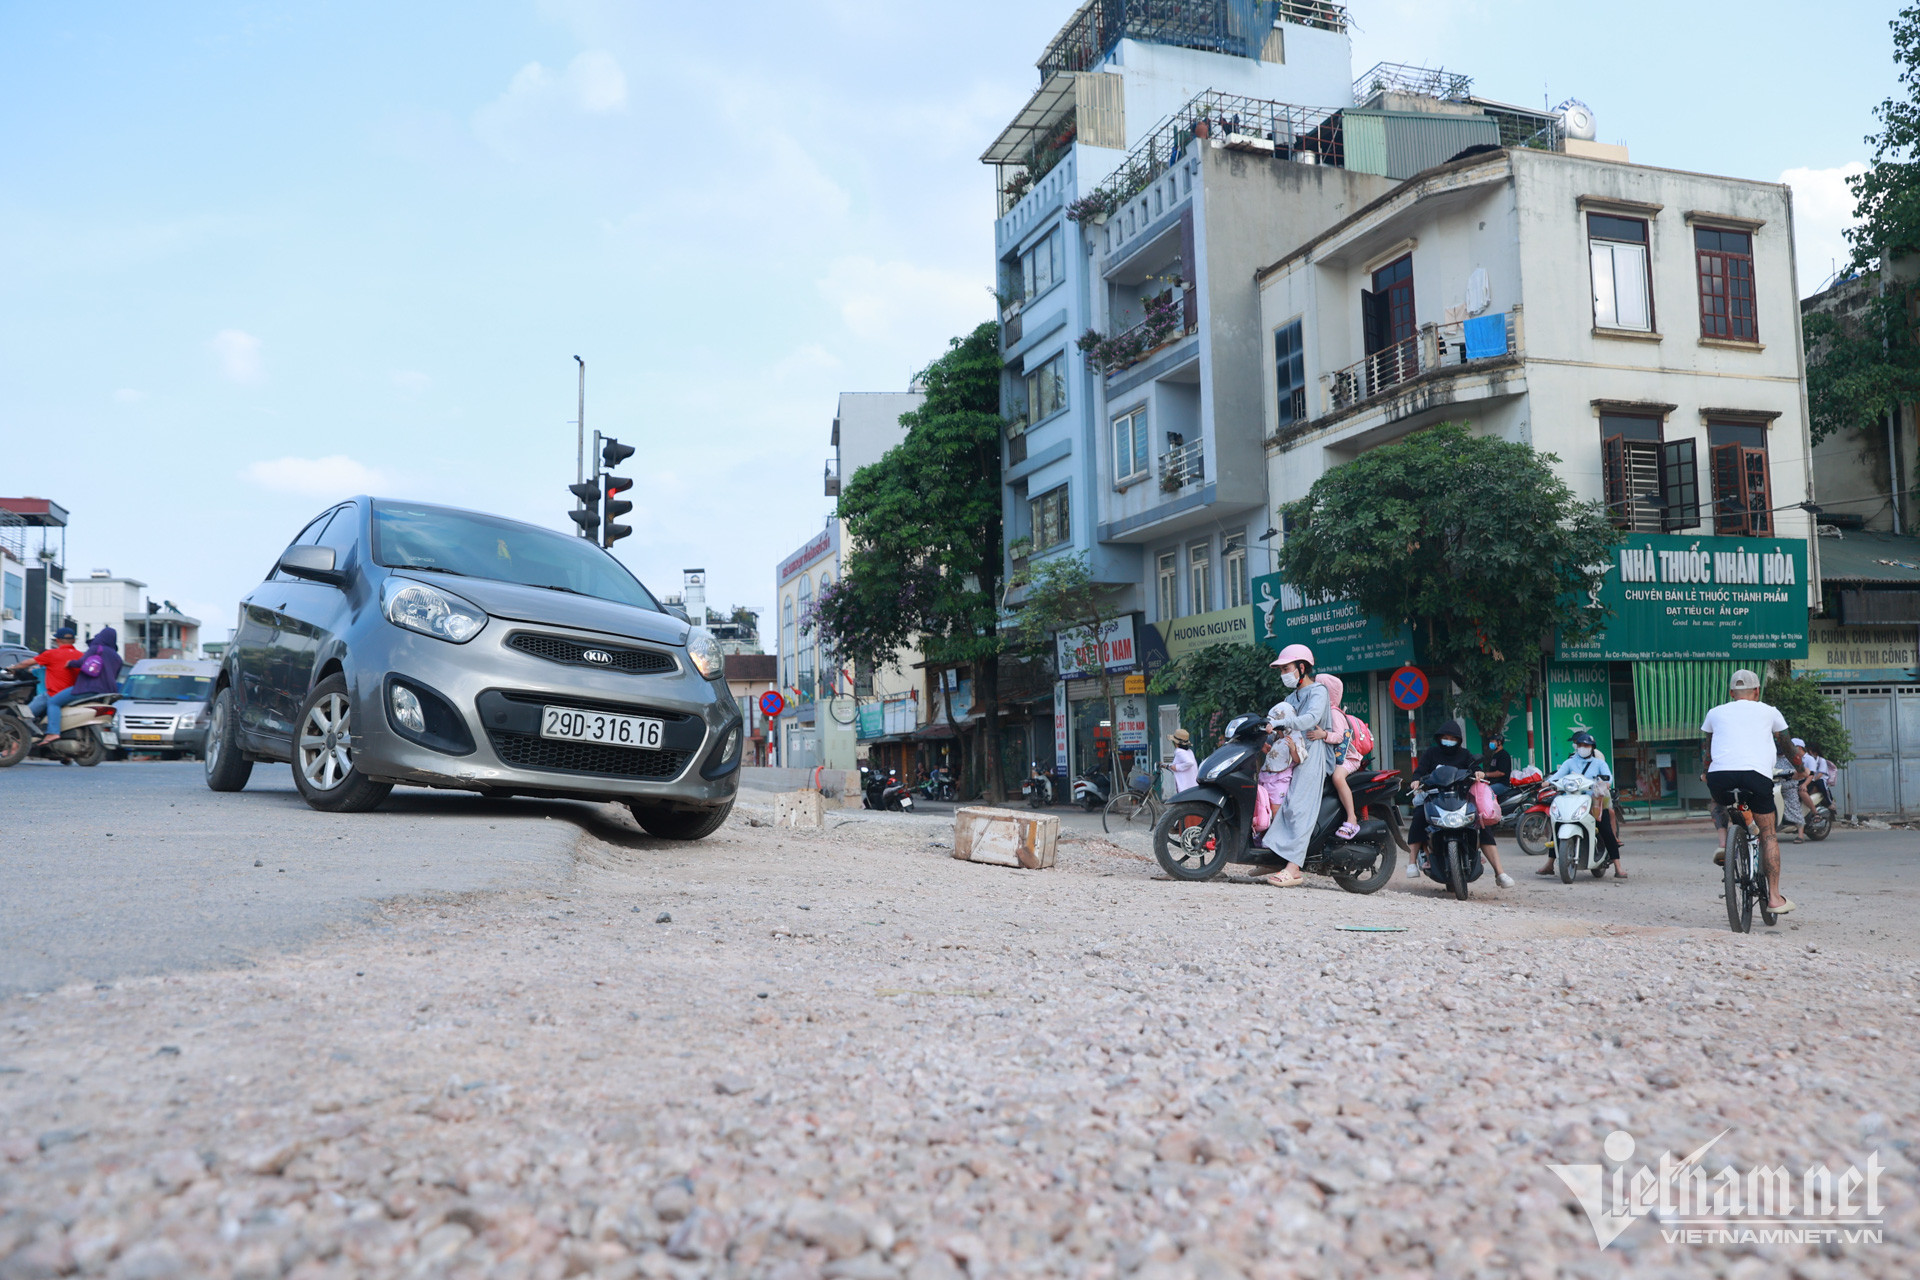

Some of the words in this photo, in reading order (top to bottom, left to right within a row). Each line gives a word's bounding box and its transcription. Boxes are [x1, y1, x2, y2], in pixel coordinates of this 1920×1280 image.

[1620, 543, 1657, 582] NHÀ
[1658, 541, 1711, 583] THUỐC
[1714, 546, 1759, 584] NHÂN
[1762, 547, 1795, 585] HÒA
[1625, 589, 1662, 601] CHUYÊN
[1665, 589, 1682, 601] BÁN
[1685, 588, 1697, 601] LẺ
[1699, 587, 1730, 602] THUỐC
[1732, 590, 1762, 602] THÀNH
[1763, 587, 1788, 602] PHẨM
[1309, 611, 1322, 623] BÁN
[1332, 603, 1354, 619] THUỐC
[1666, 606, 1681, 616] ĐẠT
[1684, 605, 1701, 615] TIÊU
[1733, 607, 1749, 616] GPP
[1174, 625, 1205, 641] HUONG
[1208, 617, 1247, 635] NGUYEN
[1311, 626, 1322, 637] ĐẠT
[1323, 623, 1335, 634] TIÊU
[1335, 616, 1355, 632] CHUẨN
[1355, 619, 1367, 629] GPP
[1719, 619, 1742, 627] practie
[588, 652, 609, 662] KIA
[1112, 638, 1132, 661] NAM
[1864, 650, 1879, 665] THI
[1550, 664, 1571, 683] NHÀ
[1573, 661, 1606, 683] THUỐC
[1553, 689, 1581, 708] NHÂN
[1583, 689, 1605, 708] HÒA
[545, 711, 660, 745] 29D-316.16
